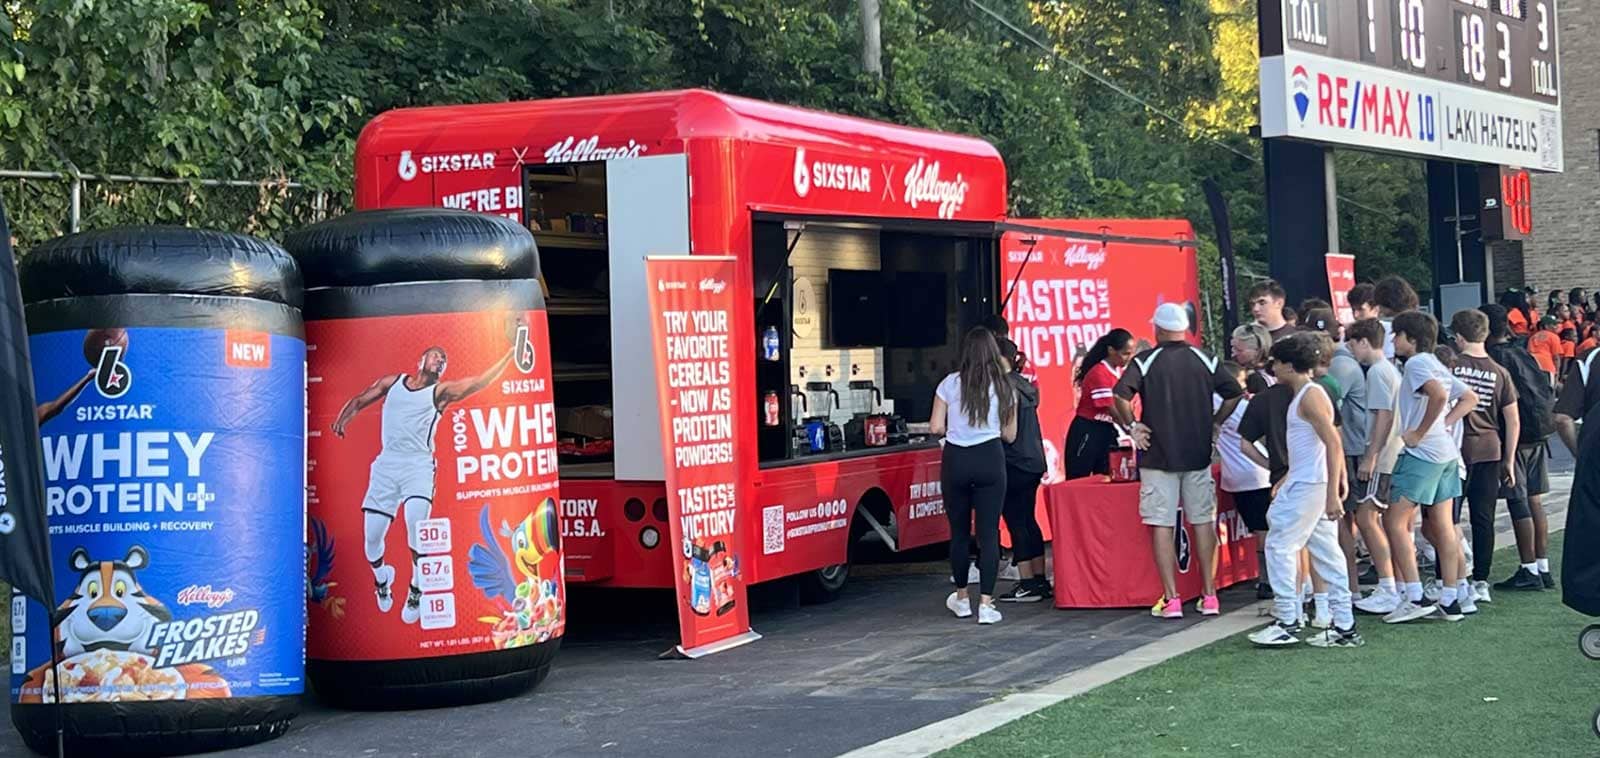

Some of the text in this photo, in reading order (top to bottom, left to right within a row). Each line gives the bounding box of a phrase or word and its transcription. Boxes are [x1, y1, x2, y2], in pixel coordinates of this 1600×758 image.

[1537, 2, 1548, 51] 3
[1461, 13, 1486, 82] 18
[1496, 21, 1512, 88] 3
[1317, 72, 1435, 142] RE/MAX 10
[1446, 106, 1538, 153] LAKI HATZELIS
[421, 152, 496, 172] SIXSTAR
[442, 187, 501, 212] WE'RE
[813, 161, 871, 192] SIXSTAR
[904, 157, 966, 219] Kellogg's
[1502, 170, 1532, 235] 40
[1064, 245, 1106, 270] Kellogg's
[1007, 279, 1098, 322] TASTES
[1097, 278, 1110, 319] LIKE
[663, 310, 728, 334] TRY YOUR
[232, 343, 265, 361] NEW
[666, 335, 728, 360] FAVORITE
[502, 379, 545, 395] SIXSTAR
[668, 361, 730, 388] CEREALS
[76, 404, 153, 421] SIXSTAR
[680, 389, 708, 414] NOW
[712, 388, 730, 411] AS
[453, 409, 466, 453] 100%
[672, 413, 732, 443] PROTEIN
[42, 432, 215, 481] WHEY
[457, 448, 558, 484] PROTEIN
[675, 441, 733, 468] POWDERS!
[456, 488, 501, 501] SUPPORTS
[678, 483, 728, 514] TASTES
[65, 524, 100, 534] MUSCLE
[103, 522, 150, 532] BUILDING
[160, 520, 214, 531] RECOVERY
[419, 528, 439, 541] 30
[680, 508, 736, 540] VICTORY
[422, 562, 442, 575] 6.7
[177, 585, 235, 608] Kellogg's
[430, 599, 444, 612] 18
[151, 610, 259, 648] FROSTED
[155, 634, 250, 667] FLAKES
